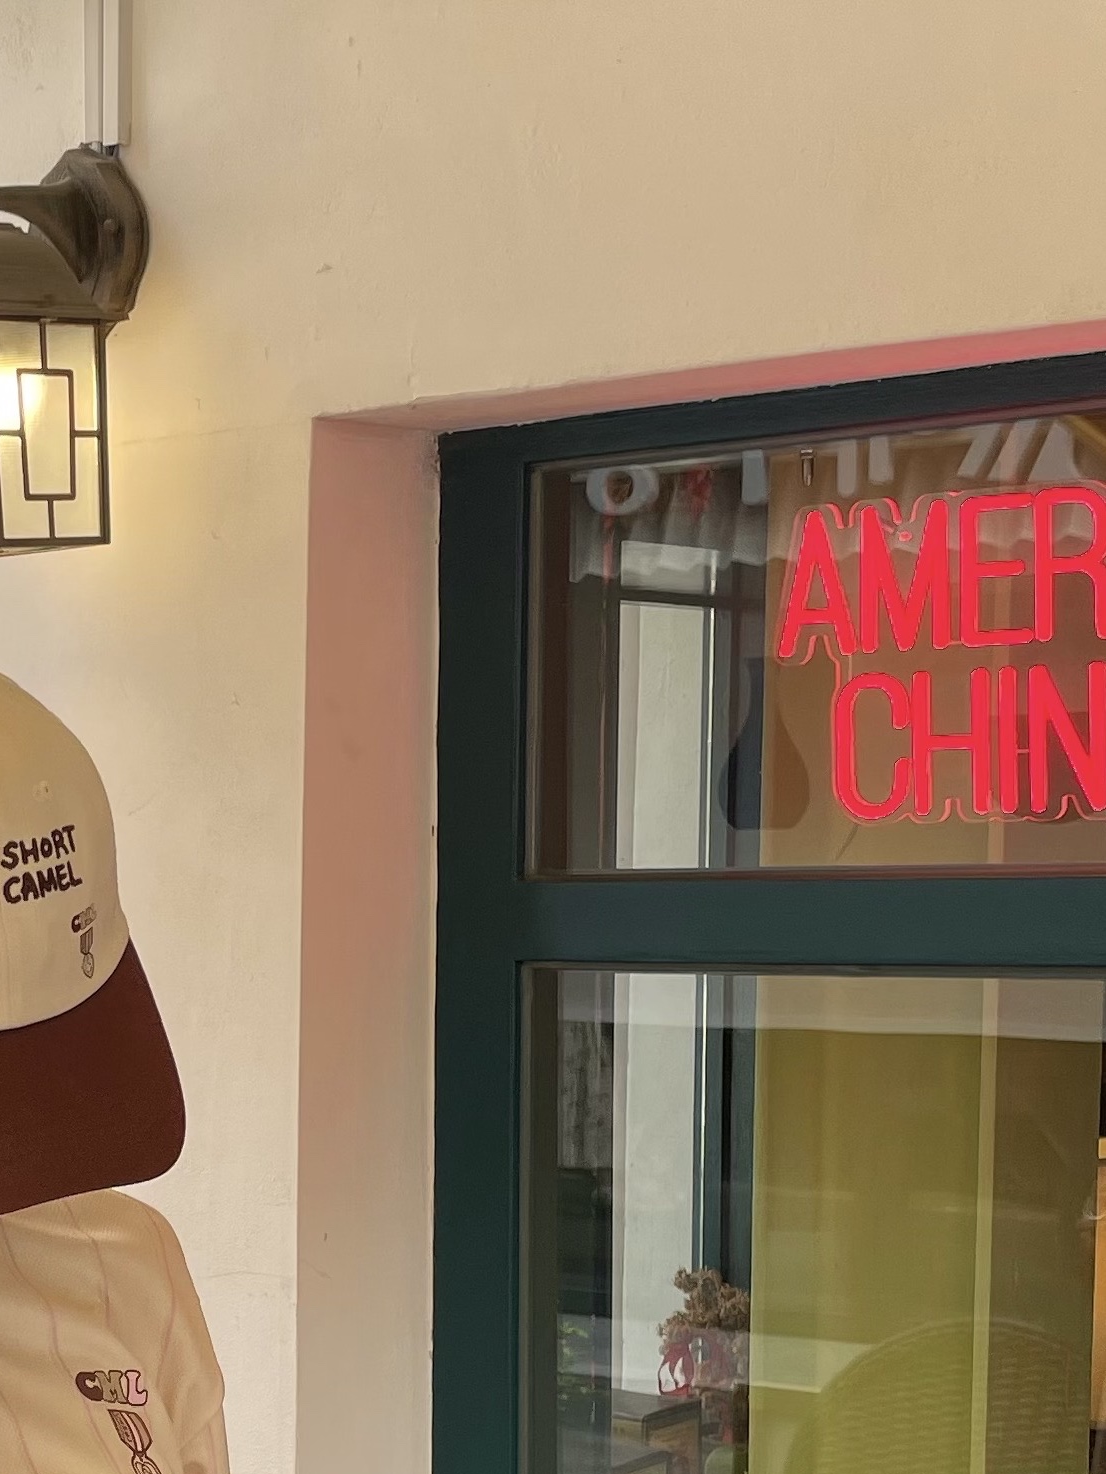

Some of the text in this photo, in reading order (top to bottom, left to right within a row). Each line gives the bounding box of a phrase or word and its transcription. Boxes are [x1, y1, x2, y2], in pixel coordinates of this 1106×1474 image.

[777, 487, 1106, 657] AMER
[836, 661, 1106, 820] CHIN
[1, 825, 76, 870] SHORT
[3, 860, 83, 904] CAMEL
[75, 1370, 148, 1406] CML
